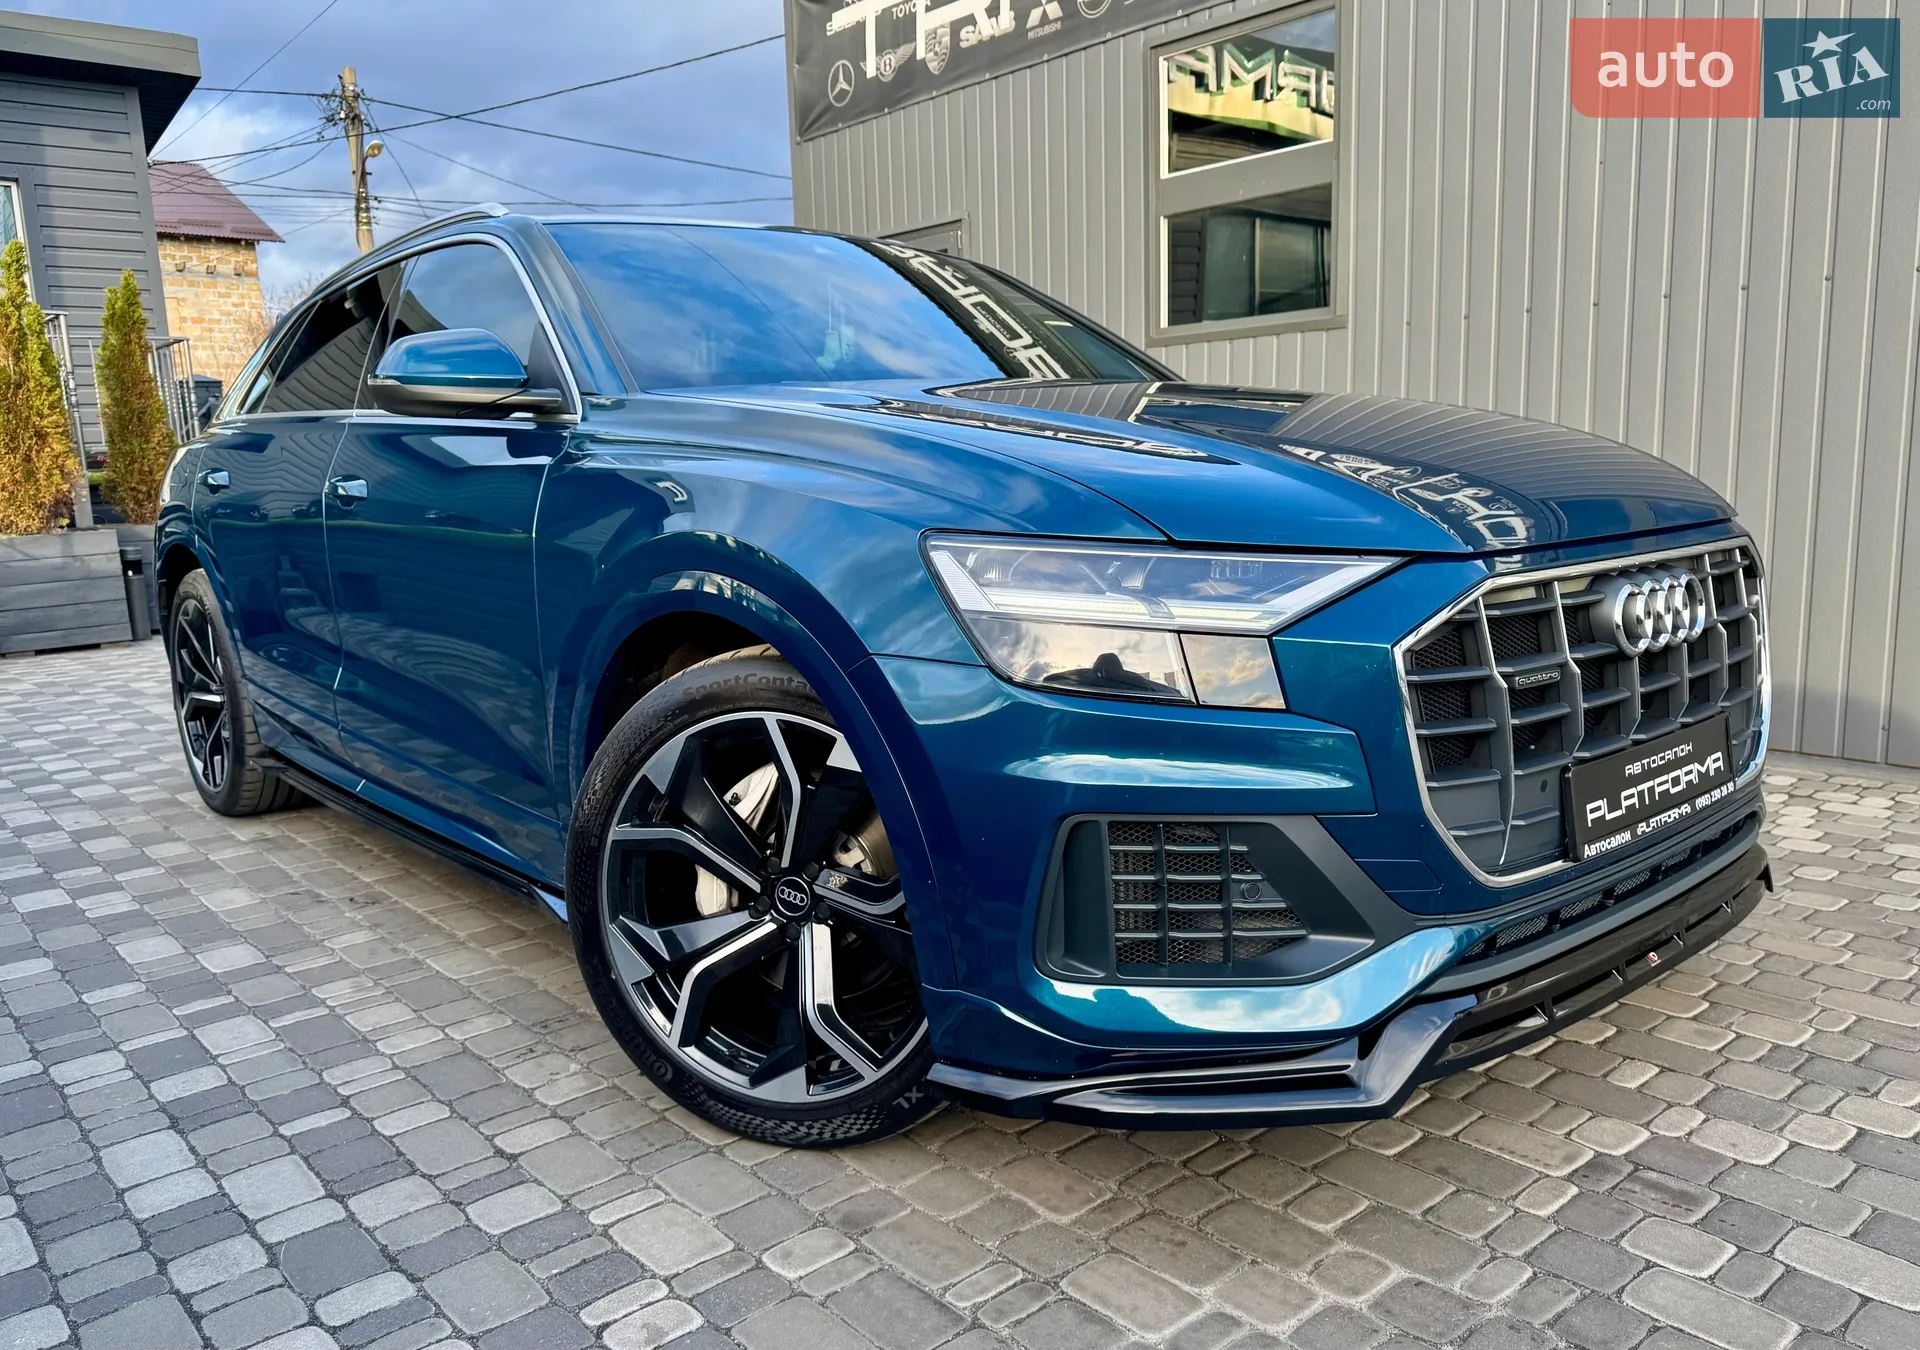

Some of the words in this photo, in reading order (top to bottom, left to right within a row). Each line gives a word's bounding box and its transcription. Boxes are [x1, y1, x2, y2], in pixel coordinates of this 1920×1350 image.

[1518, 671, 1559, 686] quattro
[1625, 742, 1693, 777] АВТОСАЛОН
[1586, 751, 1724, 827] PLATFORMA
[1584, 831, 1631, 858] Автосалон
[892, 1085, 924, 1109] XL
